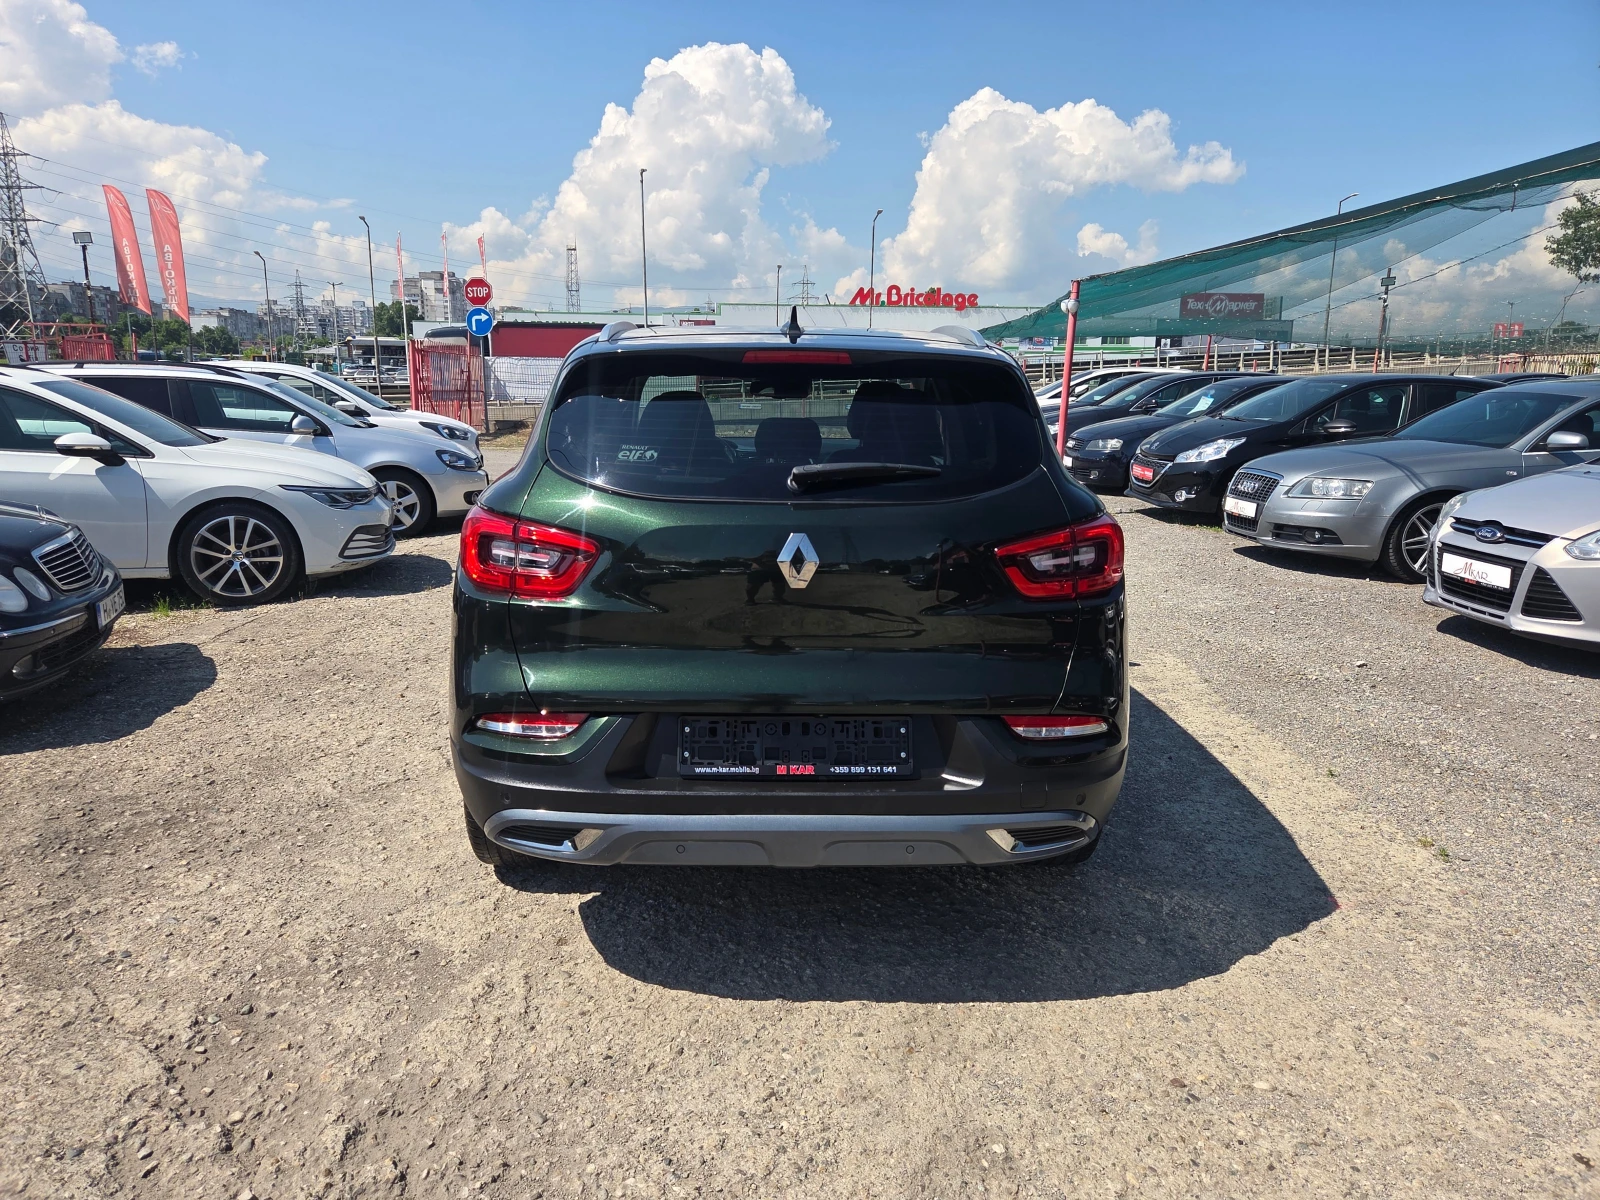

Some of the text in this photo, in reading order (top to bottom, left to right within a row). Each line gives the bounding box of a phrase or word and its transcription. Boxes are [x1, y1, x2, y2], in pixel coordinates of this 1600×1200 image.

[467, 287, 489, 298] STOP
[1478, 528, 1494, 538] Ford
[776, 765, 787, 775] M
[789, 765, 815, 775] KAR
